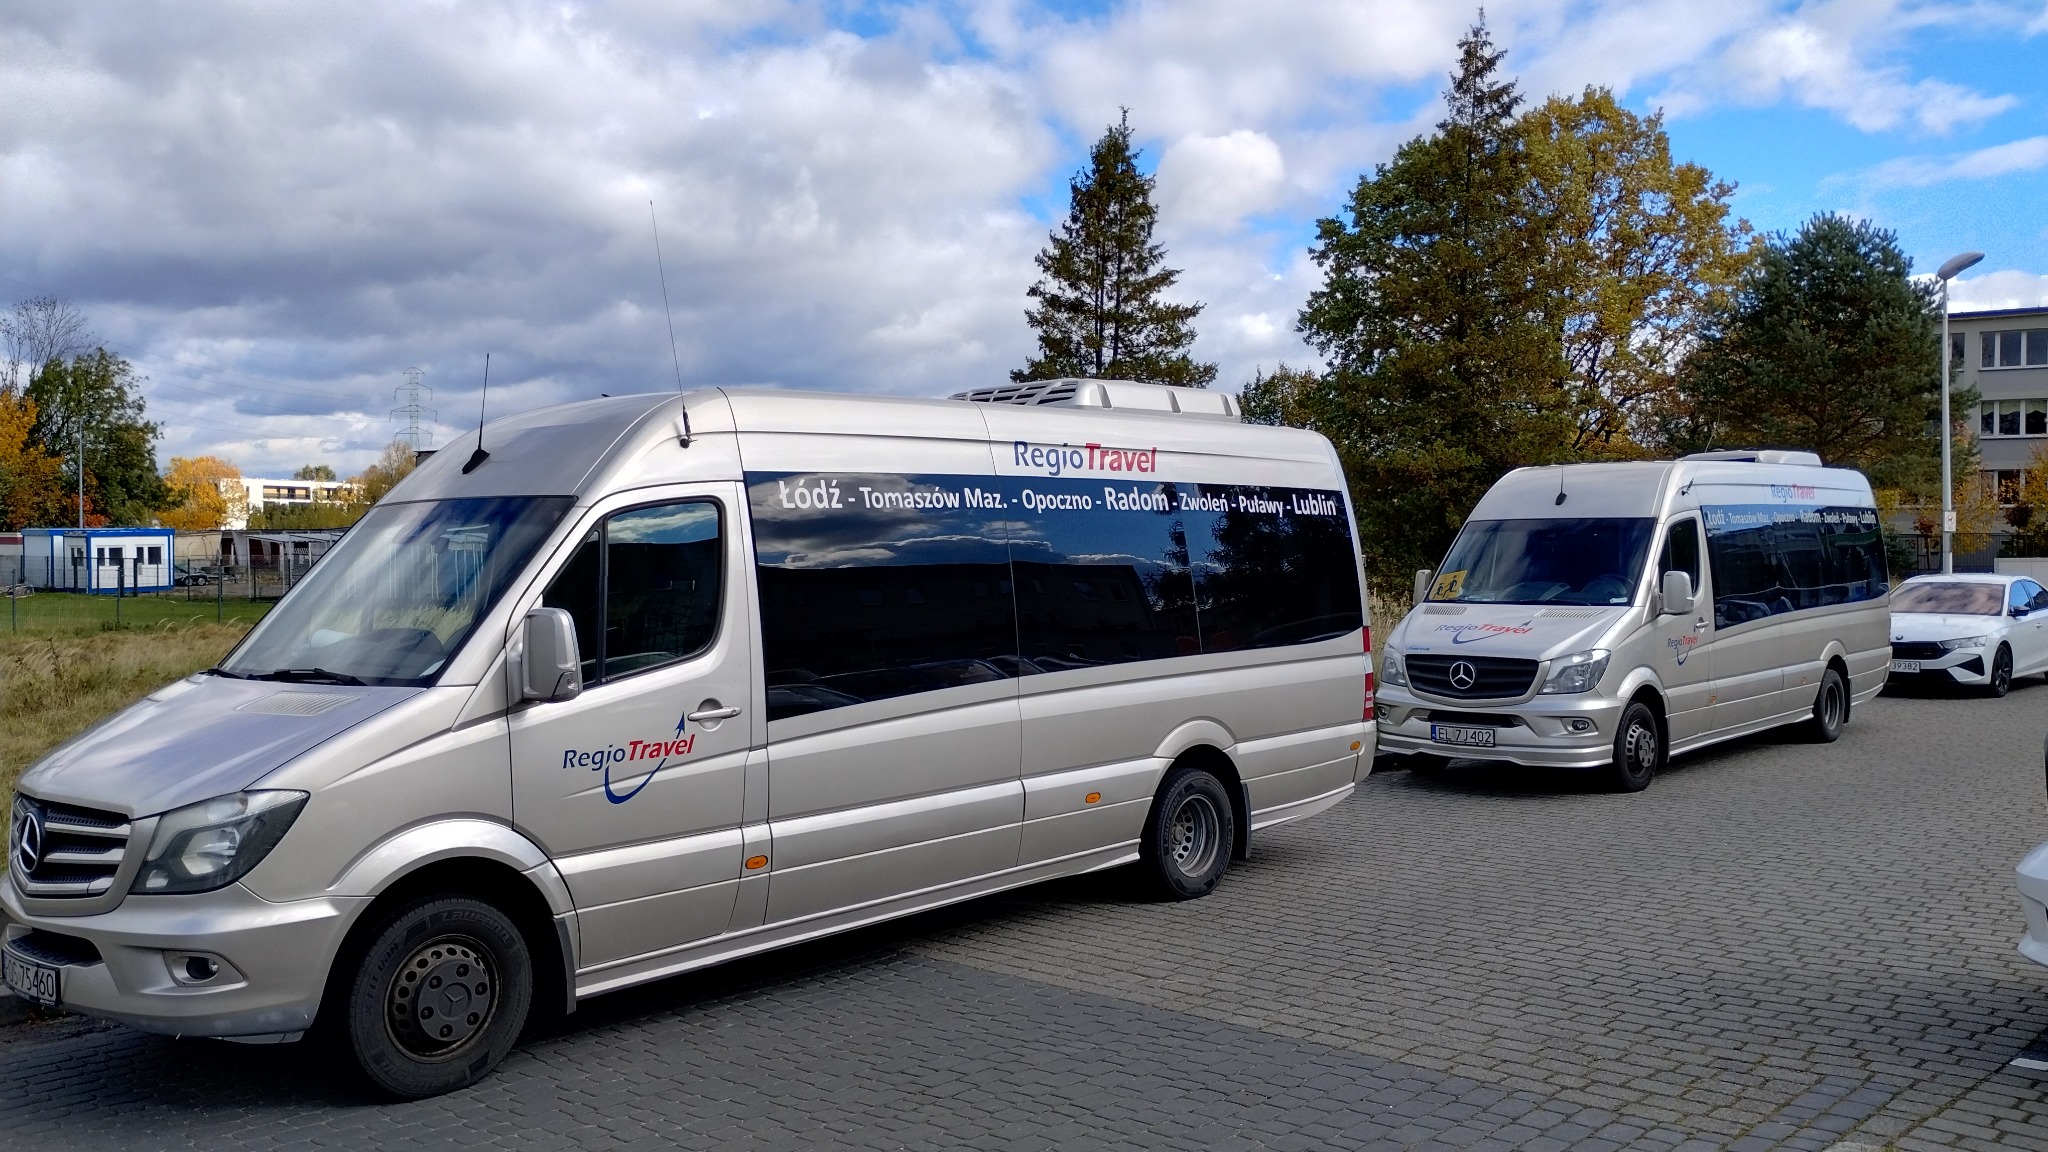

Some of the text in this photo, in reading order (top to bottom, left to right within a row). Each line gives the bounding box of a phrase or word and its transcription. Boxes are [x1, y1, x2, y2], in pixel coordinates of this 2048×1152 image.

[1013, 440, 1157, 476] RegioTravel
[778, 479, 843, 509] Łódź
[859, 486, 960, 509] Tomaszów
[964, 487, 1008, 509] Maz.
[1022, 489, 1092, 513] Opoczno
[1104, 486, 1169, 511] Radom
[1180, 492, 1229, 512] Zwoleń
[1239, 495, 1284, 517] Puławy
[1294, 493, 1337, 516] Lublin
[563, 734, 695, 771] RegioTravel
[1438, 727, 1492, 743] EL 7J402
[19, 963, 55, 998] 75460
